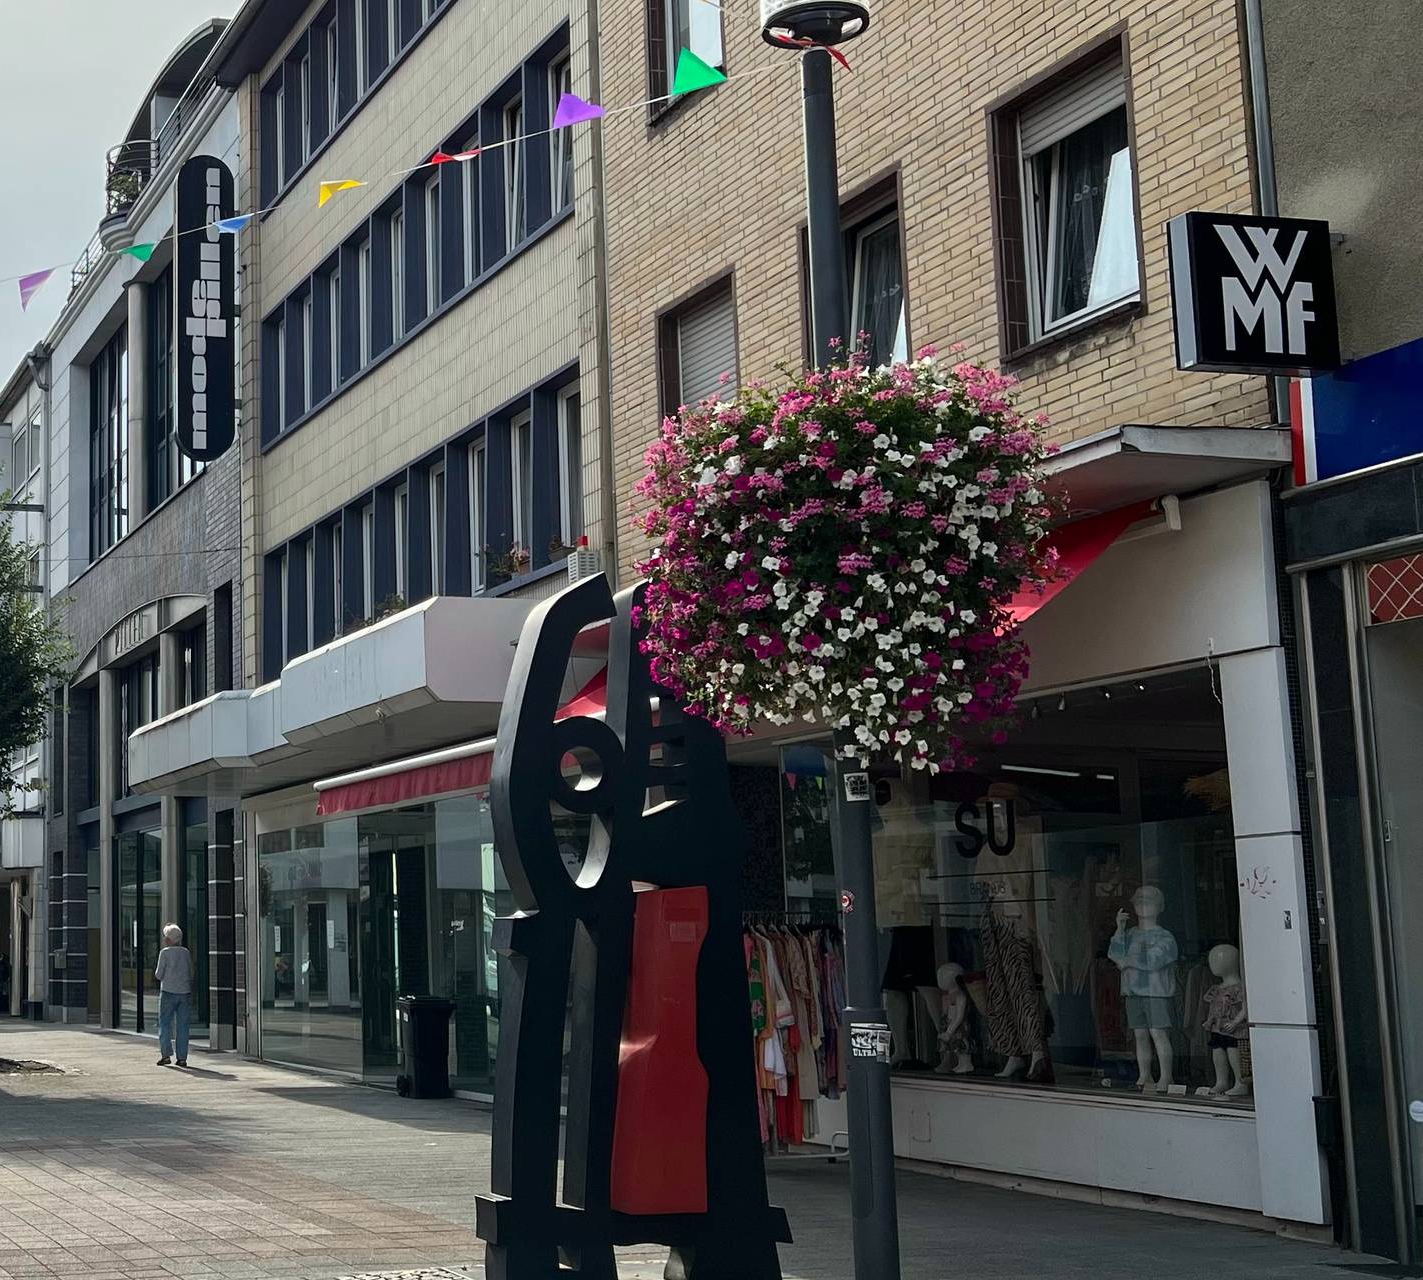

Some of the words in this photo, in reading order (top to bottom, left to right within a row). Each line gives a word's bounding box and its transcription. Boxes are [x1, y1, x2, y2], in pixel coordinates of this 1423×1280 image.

[1212, 224, 1315, 355] WMF
[186, 279, 207, 449] mode
[955, 799, 1015, 858] SU
